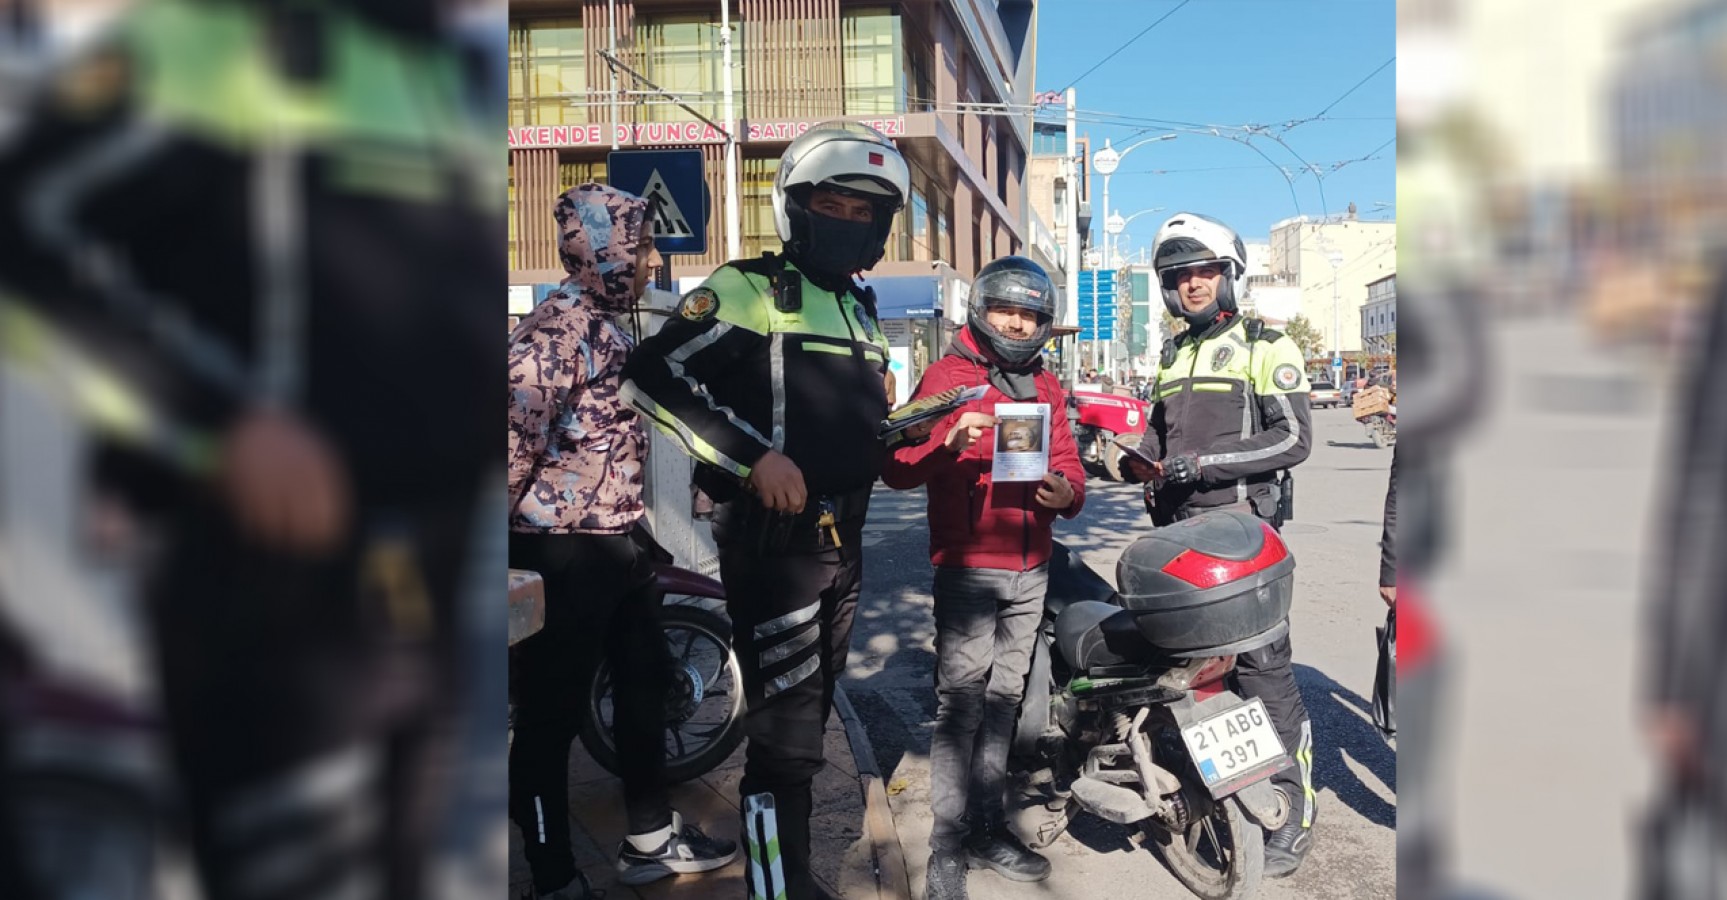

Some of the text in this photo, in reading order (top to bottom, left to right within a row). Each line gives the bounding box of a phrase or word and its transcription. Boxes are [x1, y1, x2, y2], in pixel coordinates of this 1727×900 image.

[1194, 708, 1263, 750] 21 ABG
[1220, 739, 1259, 769] 397
